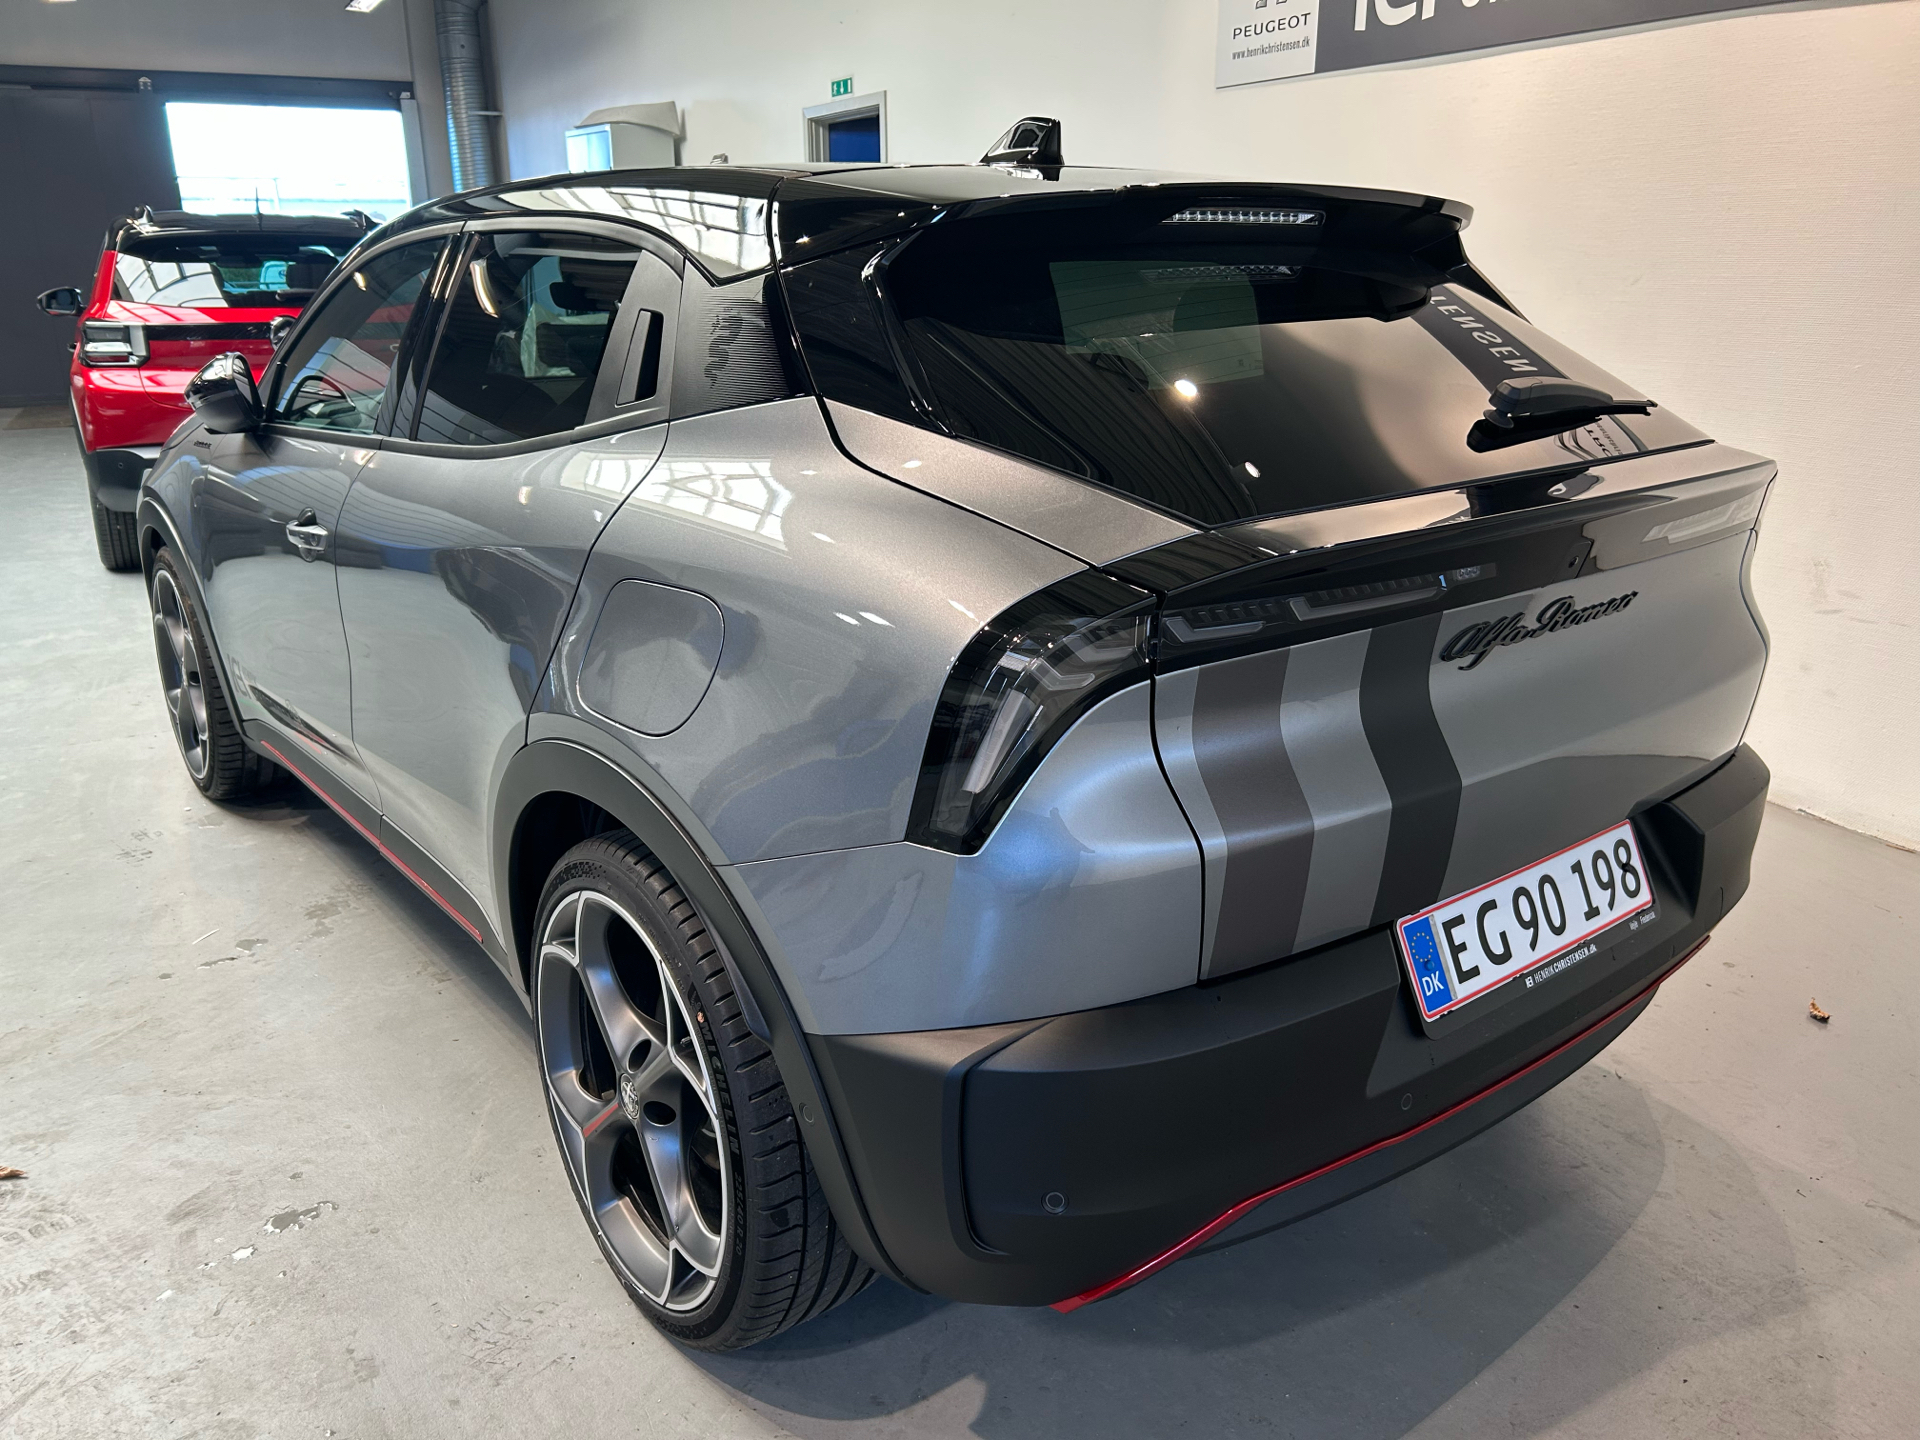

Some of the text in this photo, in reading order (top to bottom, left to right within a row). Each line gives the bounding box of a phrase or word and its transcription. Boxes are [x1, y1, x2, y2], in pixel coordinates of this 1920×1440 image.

[1231, 36, 1311, 60] www.henrikchristensen.dk
[1232, 12, 1311, 39] PEUGEOT
[1439, 590, 1639, 671] Alfa Romeo
[1570, 838, 1641, 921] 198
[1421, 971, 1445, 997] DK
[699, 1020, 740, 1156] MICHELIN
[733, 1171, 744, 1225] 225/40
